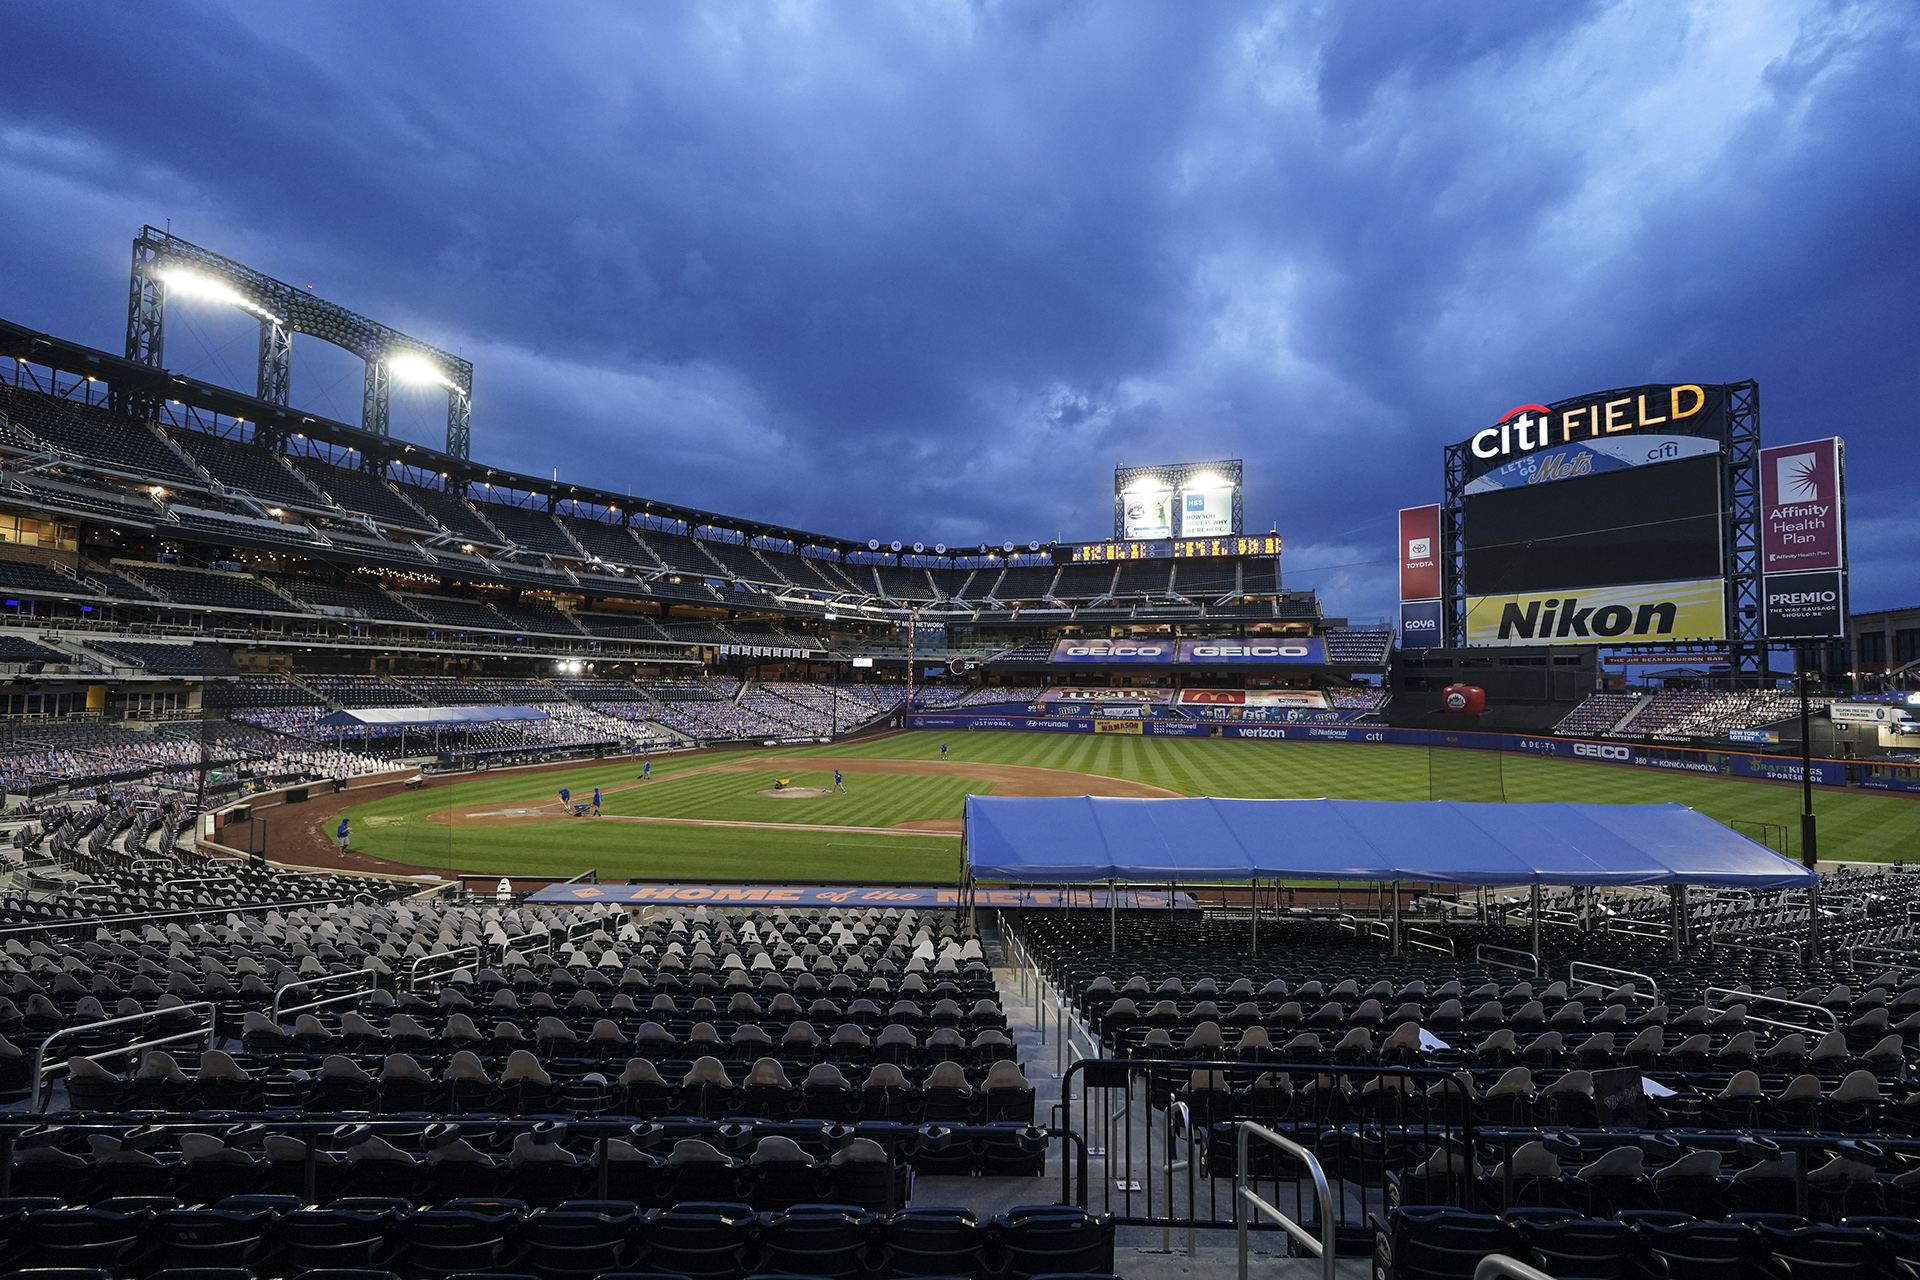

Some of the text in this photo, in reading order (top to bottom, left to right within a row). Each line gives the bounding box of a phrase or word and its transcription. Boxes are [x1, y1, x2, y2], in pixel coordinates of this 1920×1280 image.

[1471, 384, 1705, 459] citi FIELD
[1647, 442, 1678, 460] citi
[1500, 456, 1536, 476] LET'S
[1519, 465, 1538, 477] GO
[1528, 451, 1593, 484] Mets
[1769, 504, 1829, 520] Affinity
[1773, 518, 1825, 533] Health
[1783, 534, 1816, 545] Plan
[1406, 560, 1434, 569] TOYOTA
[1769, 591, 1836, 605] PREMIO
[1405, 620, 1436, 629] GOYA
[1497, 598, 1677, 640] Nikon
[1067, 647, 1161, 656] GEICO
[1193, 646, 1308, 656] GEICO
[1239, 727, 1285, 738] verizon
[1318, 729, 1348, 737] National
[1366, 732, 1383, 741] citi
[1529, 741, 1555, 749] DETA
[1574, 743, 1629, 760] GEICO
[1659, 760, 1717, 772] KONICA MINOLTA
[1767, 772, 1822, 782] SPORTSBOK
[630, 888, 1099, 905] HOME of the METS
